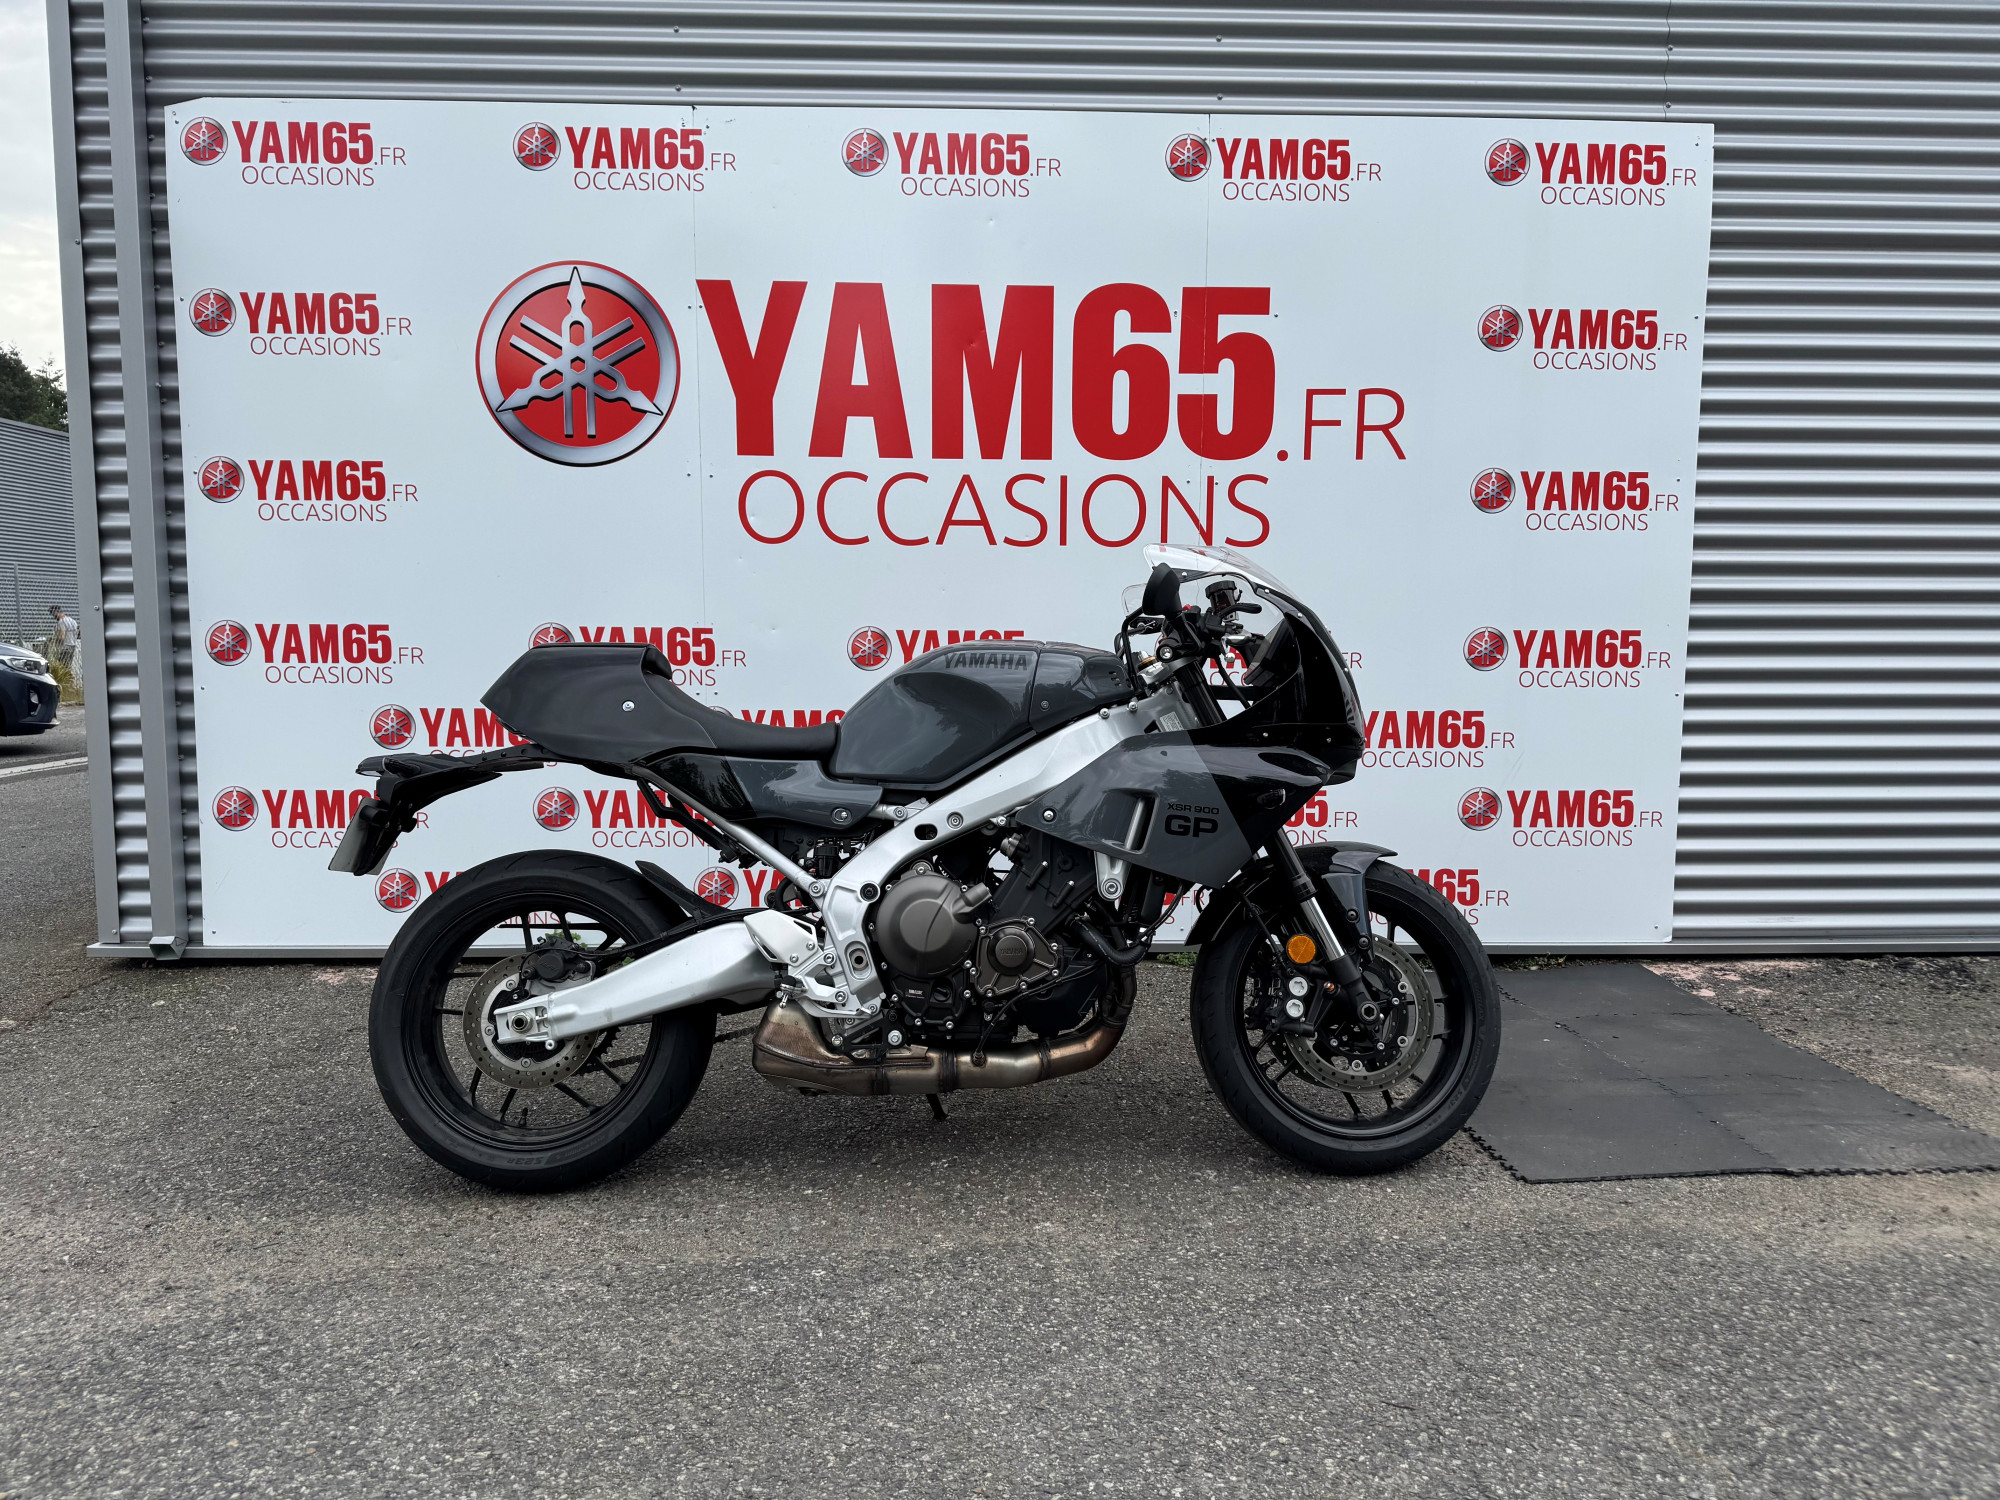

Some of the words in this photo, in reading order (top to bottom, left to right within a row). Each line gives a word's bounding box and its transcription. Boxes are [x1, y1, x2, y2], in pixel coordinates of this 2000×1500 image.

[232, 122, 405, 166] YAM65.FR
[565, 127, 735, 171] YAM65.FR
[893, 133, 1061, 177] YAM65.FR
[1216, 137, 1381, 182] YAM65.FR
[1536, 142, 1696, 187] YAM65.FR
[242, 166, 374, 187] OCCASIONS
[575, 171, 704, 193] OCCASIONS
[901, 177, 1029, 198] OCCASIONS
[1223, 183, 1349, 203] OCCASIONS
[1541, 188, 1665, 207] OCCASIONS
[240, 293, 411, 336] YAM65.FR
[1528, 308, 1687, 351] YAM65.FR
[251, 338, 380, 357] OCCASIONS
[696, 280, 1406, 462] YAM65.FR
[1534, 353, 1656, 371] OCCASIONS
[248, 461, 417, 503] YAM65.FR
[1521, 472, 1678, 512] YAM65.FR
[259, 504, 387, 522] OCCASIONS
[738, 471, 1270, 549] OCCASIONS
[1527, 514, 1648, 532] OCCASIONS
[255, 623, 423, 665] YAM65.FR
[1513, 630, 1670, 670] YAM65.FR
[944, 652, 1028, 671] YAMAHA
[266, 667, 392, 685] OCCASIONS
[1519, 672, 1640, 689] OCCASIONS
[1362, 752, 1484, 769] OCCASIONS
[1167, 802, 1192, 812] XSR
[1194, 805, 1220, 815] 900
[1507, 789, 1662, 829] YAM65.FR
[1165, 814, 1219, 838] GP
[592, 832, 705, 849] OCCASION
[1513, 830, 1632, 848] OCCASIONS
